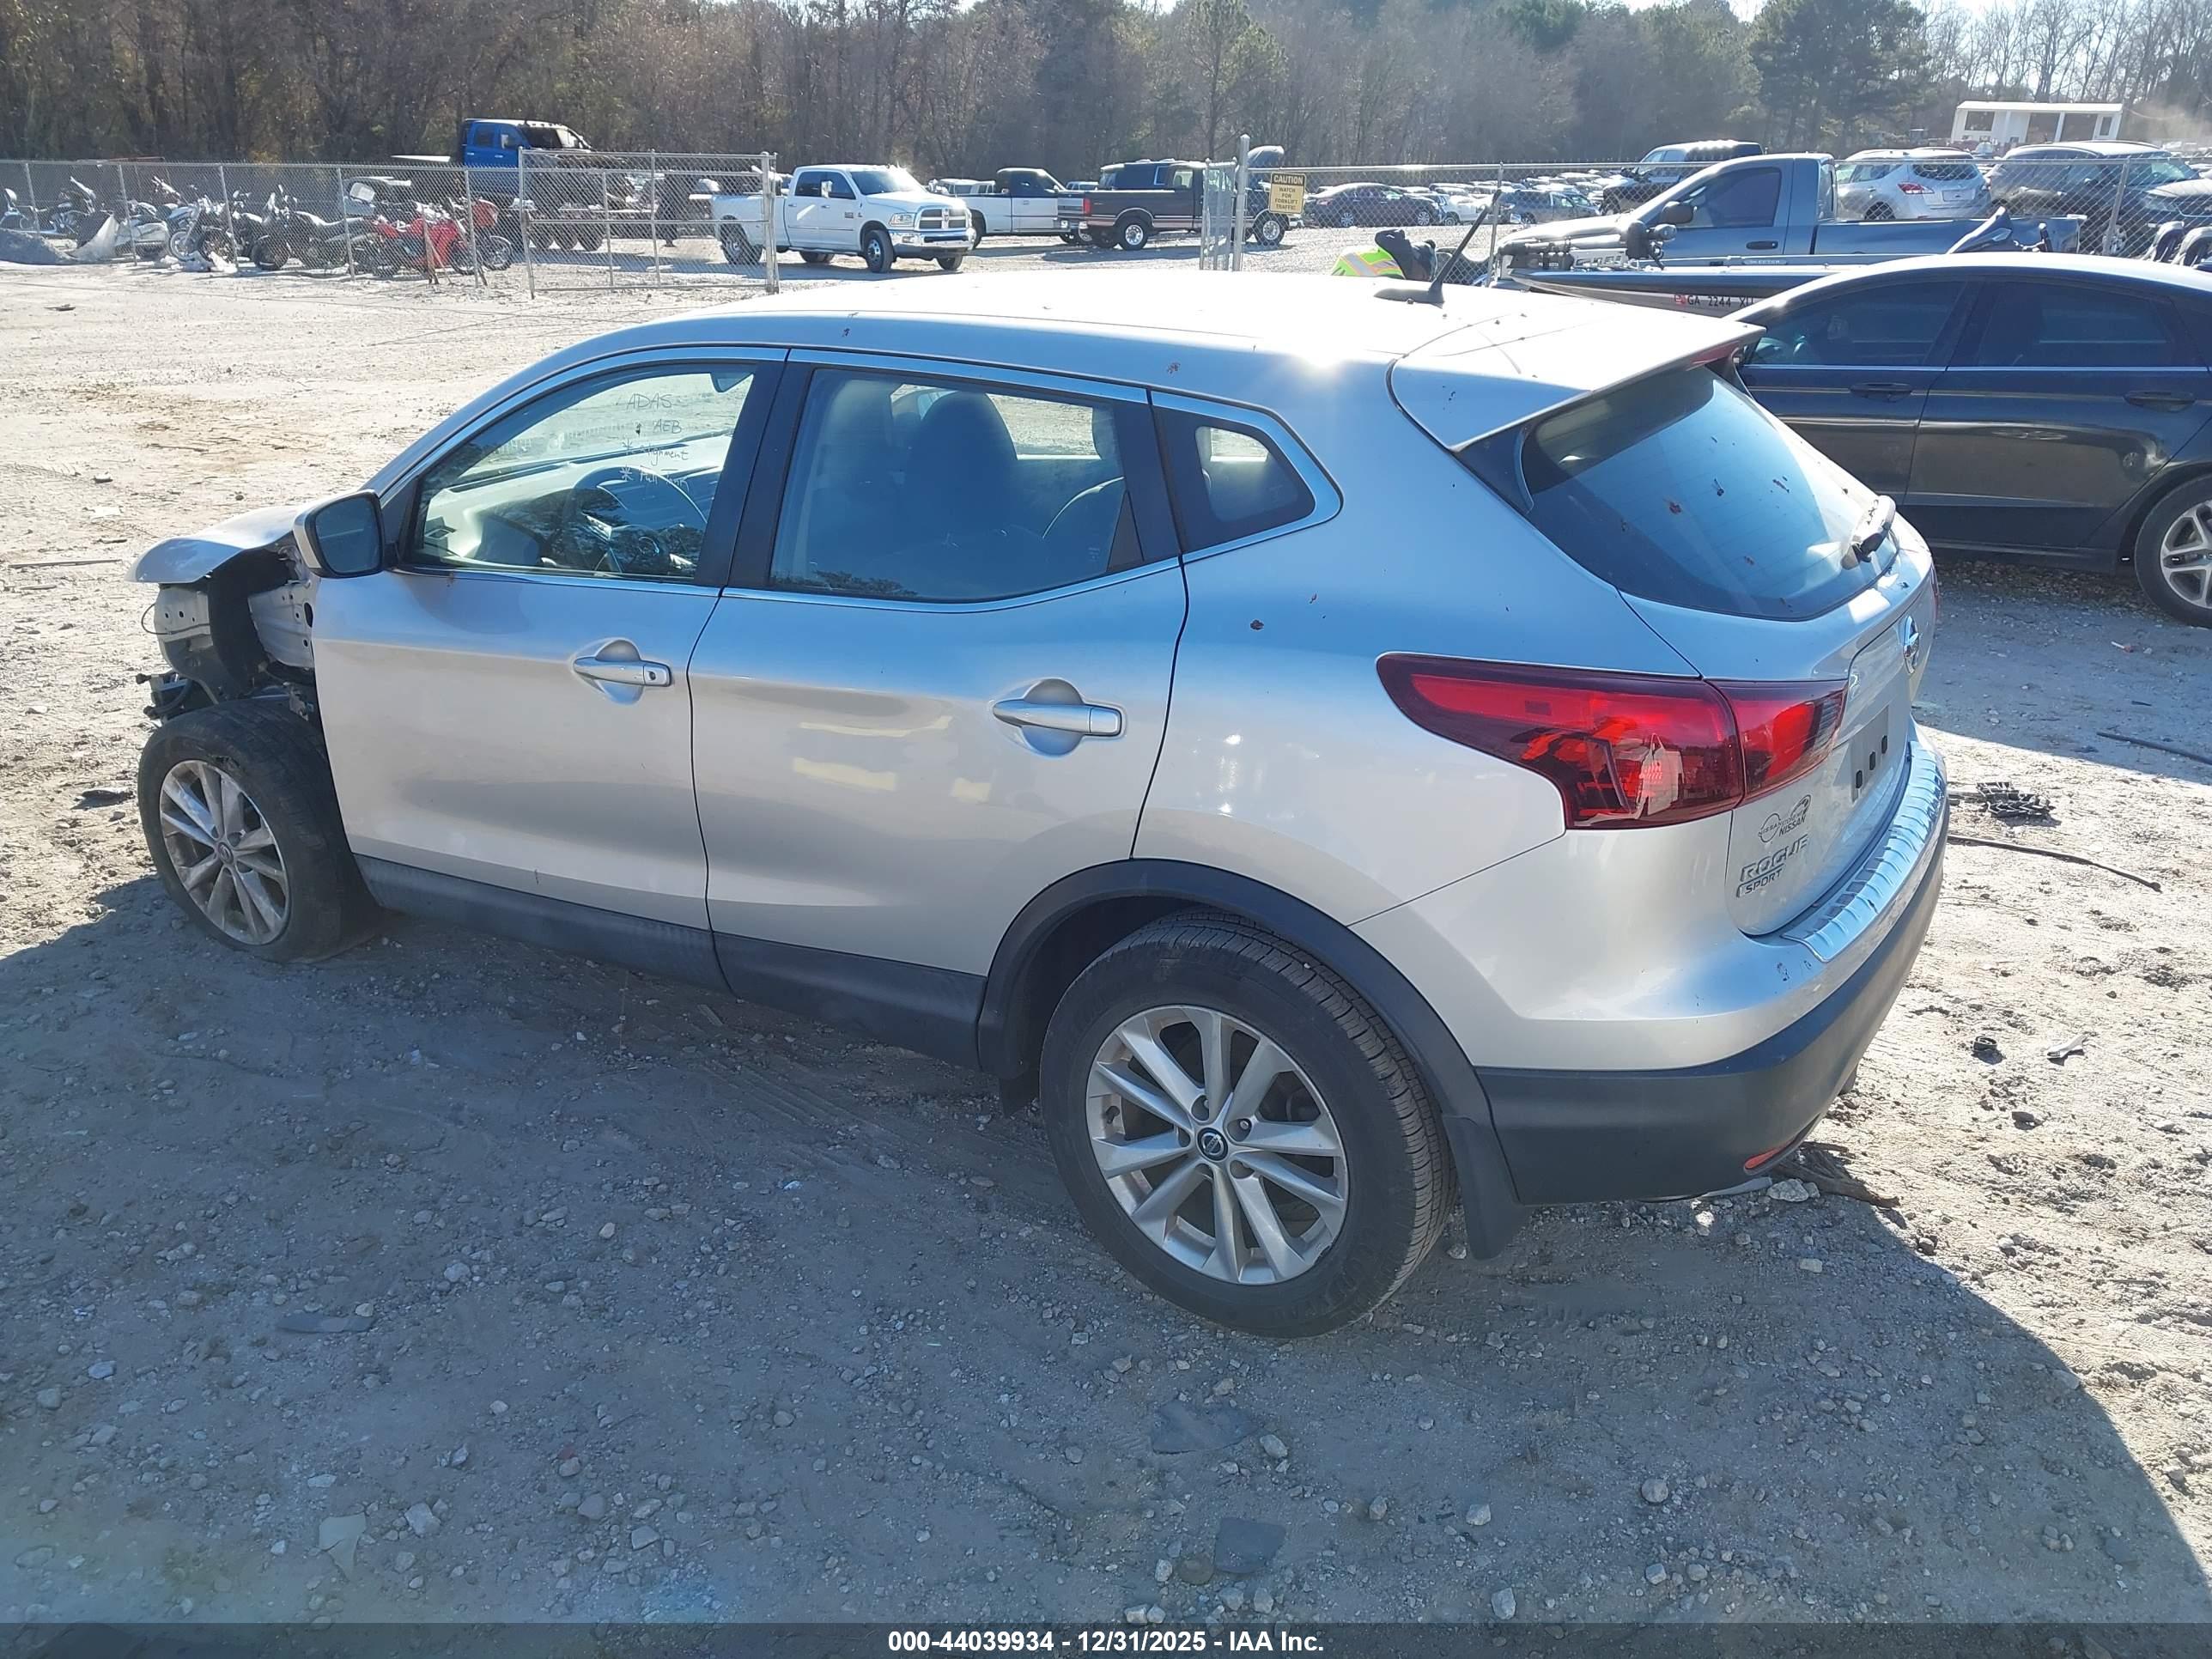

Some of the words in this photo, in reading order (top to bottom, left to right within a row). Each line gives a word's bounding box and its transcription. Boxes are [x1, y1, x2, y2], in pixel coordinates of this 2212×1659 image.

[1273, 175, 1303, 185] CAUTION
[1687, 295, 1700, 306] GA
[1708, 295, 1731, 307] 2244
[626, 392, 673, 410] ADAS
[653, 418, 683, 434] AEB
[1778, 815, 1807, 837] NISSAN
[1740, 833, 1809, 883] ROGUE
[1745, 868, 1784, 895] SPORT
